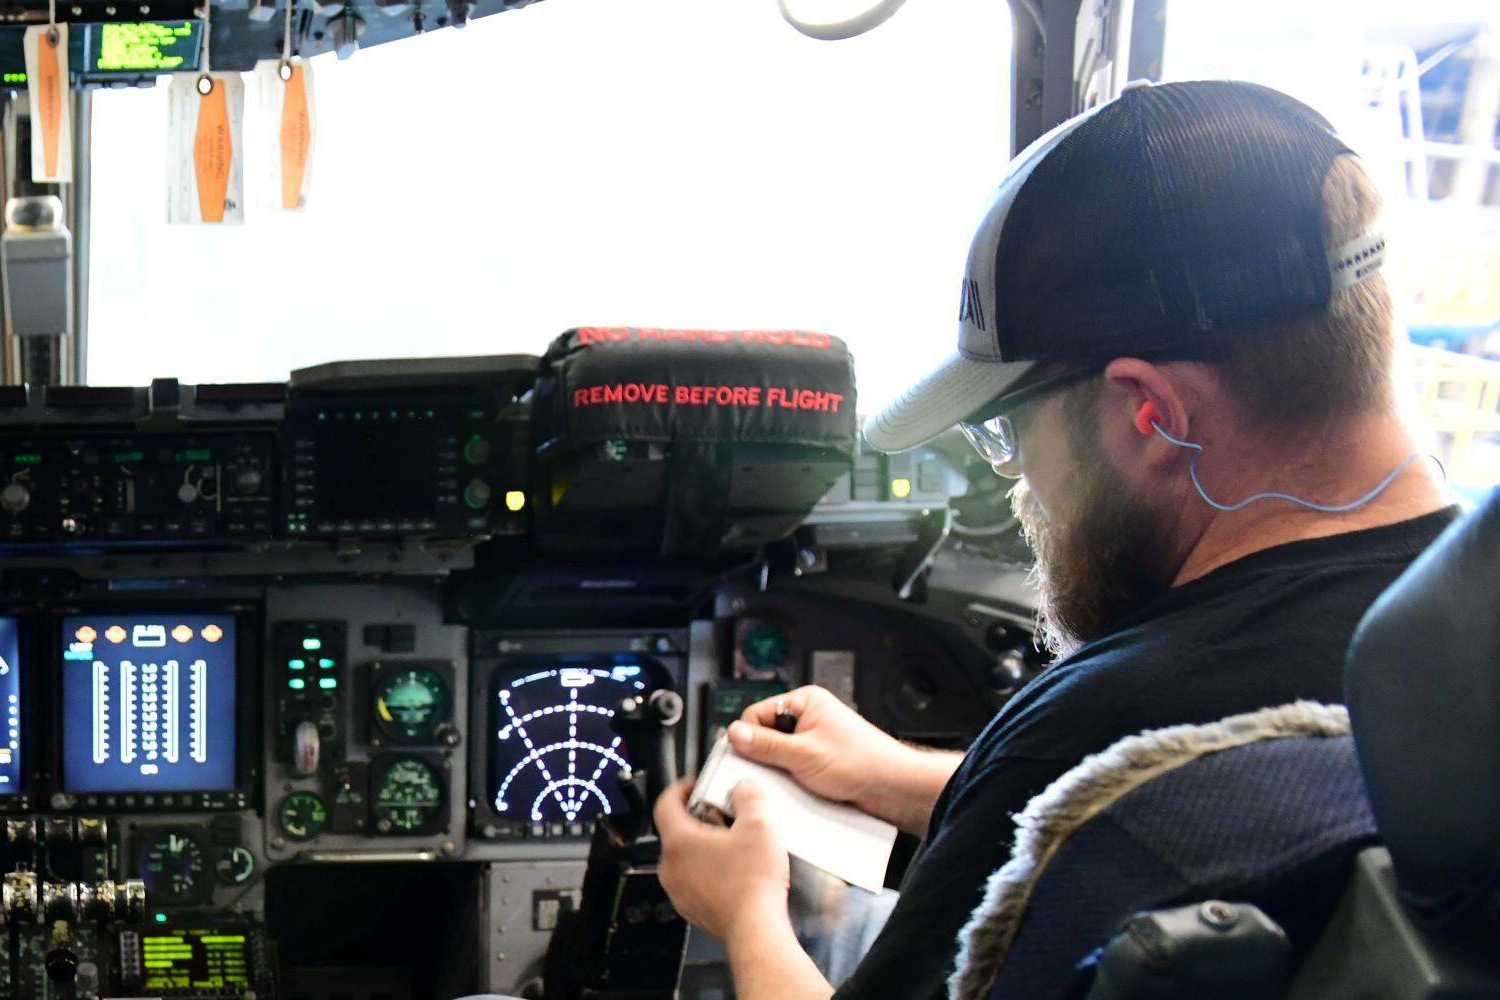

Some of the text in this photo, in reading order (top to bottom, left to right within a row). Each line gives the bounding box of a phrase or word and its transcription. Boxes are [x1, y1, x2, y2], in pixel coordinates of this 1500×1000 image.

[574, 383, 844, 413] REMOVE BEFORE FLIGHT
